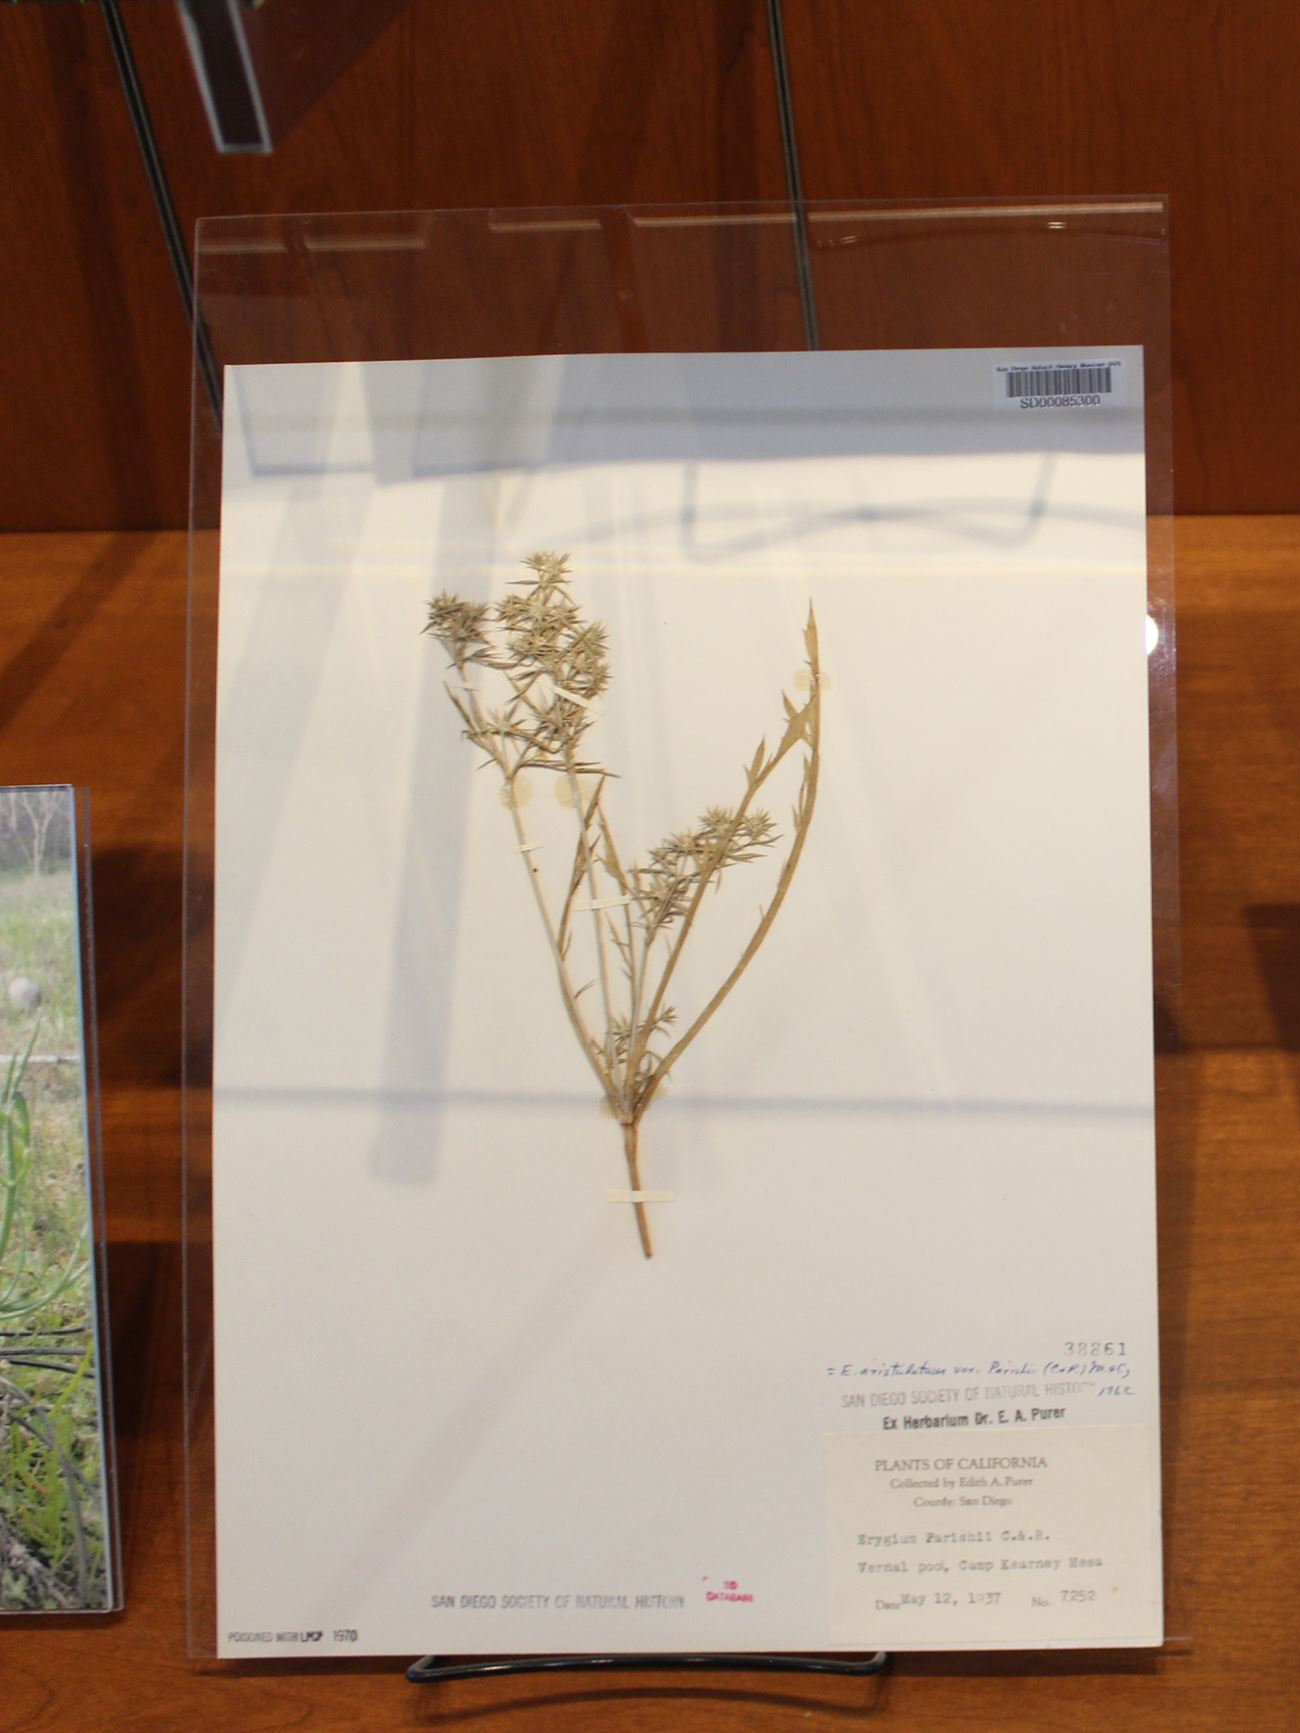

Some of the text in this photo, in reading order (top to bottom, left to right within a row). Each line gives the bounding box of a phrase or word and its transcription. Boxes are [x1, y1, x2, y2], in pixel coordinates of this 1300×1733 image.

[1020, 395, 1100, 409] SD00085300
[841, 1394, 865, 1408] SAN
[871, 1391, 906, 1406] DIEGO
[911, 1388, 960, 1405] SOCIETY
[965, 1387, 979, 1401] OF
[985, 1384, 1040, 1400] NATURAL
[883, 1407, 1066, 1430] Ex Herbarium Dr. E. A. Purer
[875, 1457, 1048, 1471] PLANTS OF CALIFORNIA
[890, 1476, 1033, 1490] Collected by Edith A. Purer
[960, 1496, 979, 1506] San
[982, 1496, 1012, 1507] Diego
[926, 1531, 992, 1544] Parishii
[858, 1561, 908, 1573] Vernal
[959, 1559, 994, 1572] Camp
[1001, 1558, 1060, 1570] Kearney
[1069, 1556, 1102, 1567] Mesa
[431, 1595, 455, 1608] SAN
[460, 1595, 496, 1608] DIEGO
[501, 1594, 550, 1608] SOCIETY
[900, 1594, 926, 1606] May
[935, 1593, 957, 1606] 12,
[1060, 1590, 1096, 1602] 7252
